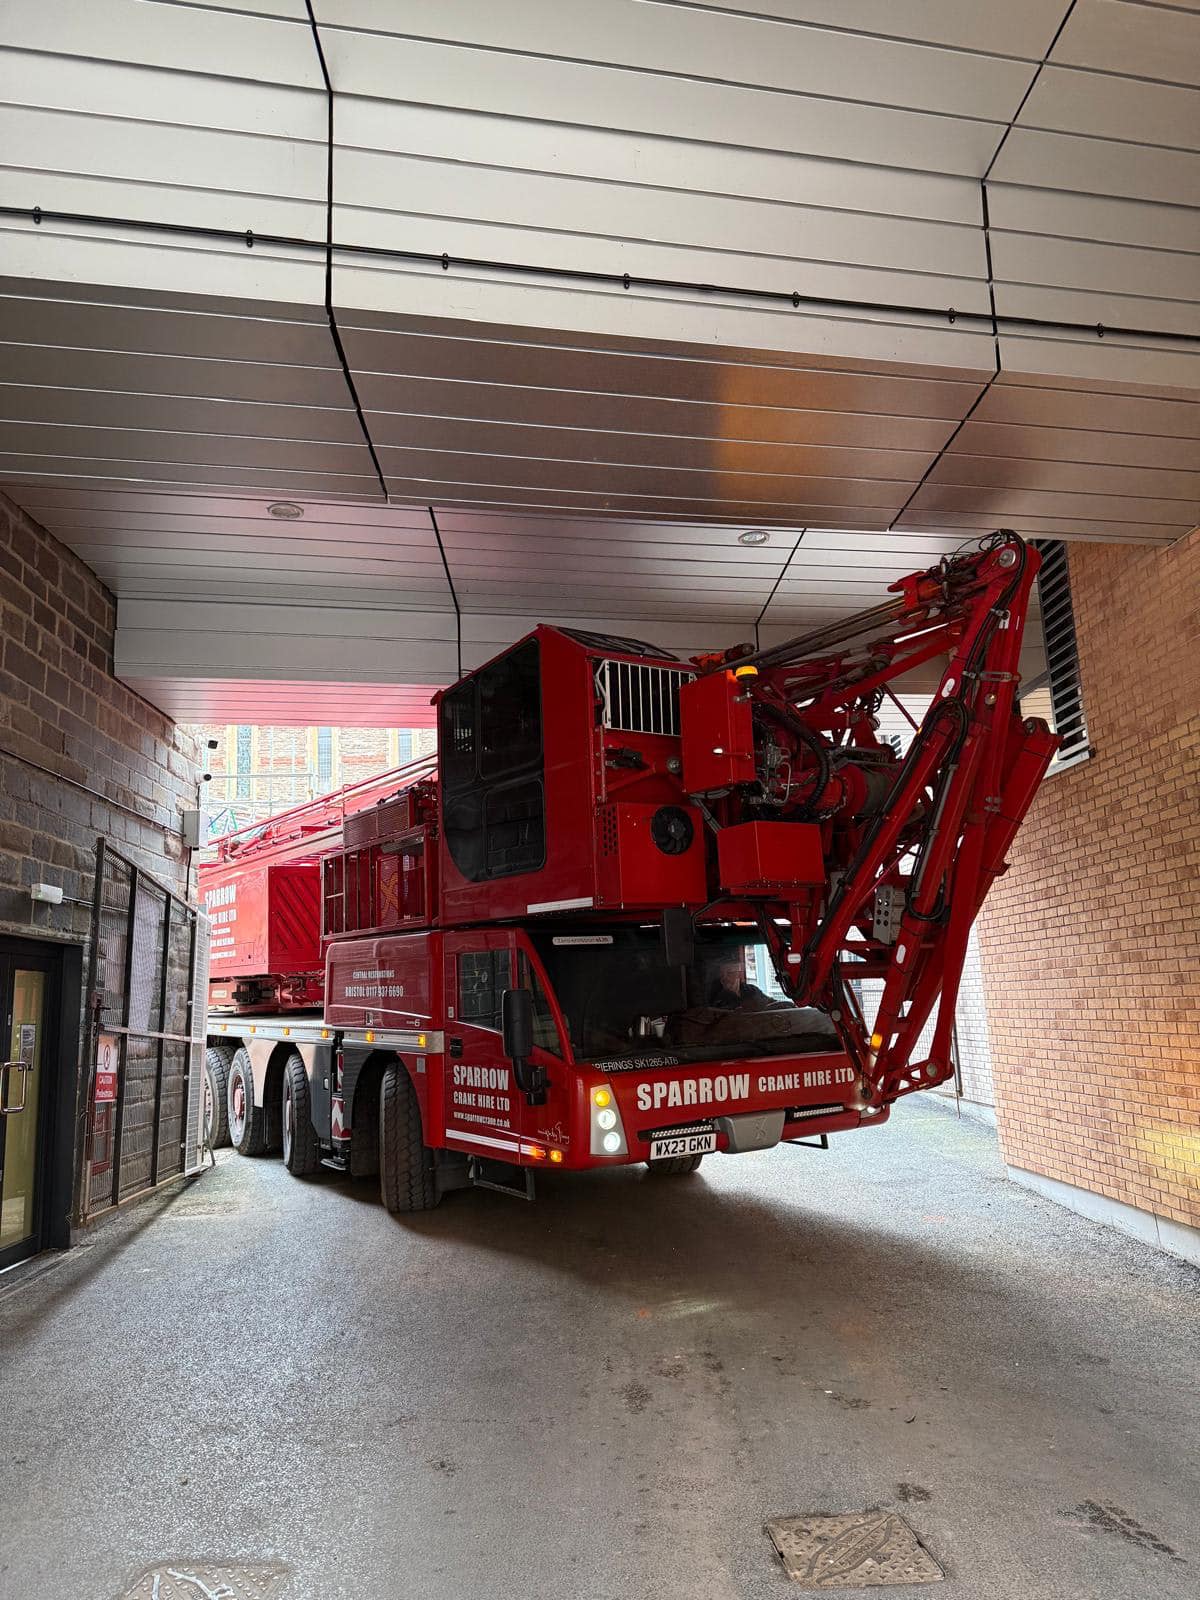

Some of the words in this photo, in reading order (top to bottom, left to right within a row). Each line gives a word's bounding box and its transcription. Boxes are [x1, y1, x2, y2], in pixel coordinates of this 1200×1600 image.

[205, 884, 237, 909] SPARROW
[345, 985, 365, 997] BRISTOL
[366, 985, 377, 997] 0117
[378, 985, 388, 997] 937
[389, 985, 404, 997] 6690
[453, 1064, 509, 1091] SPARROW
[637, 1073, 750, 1111] SPARROW
[758, 1073, 800, 1092] CRANE
[803, 1069, 832, 1088] HIRE
[835, 1067, 855, 1084] LTD
[453, 1091, 476, 1107] CRANE
[477, 1094, 495, 1110] HIRE
[496, 1096, 510, 1112] LTD
[655, 1139, 687, 1156] WX23
[689, 1136, 712, 1152] GKN
